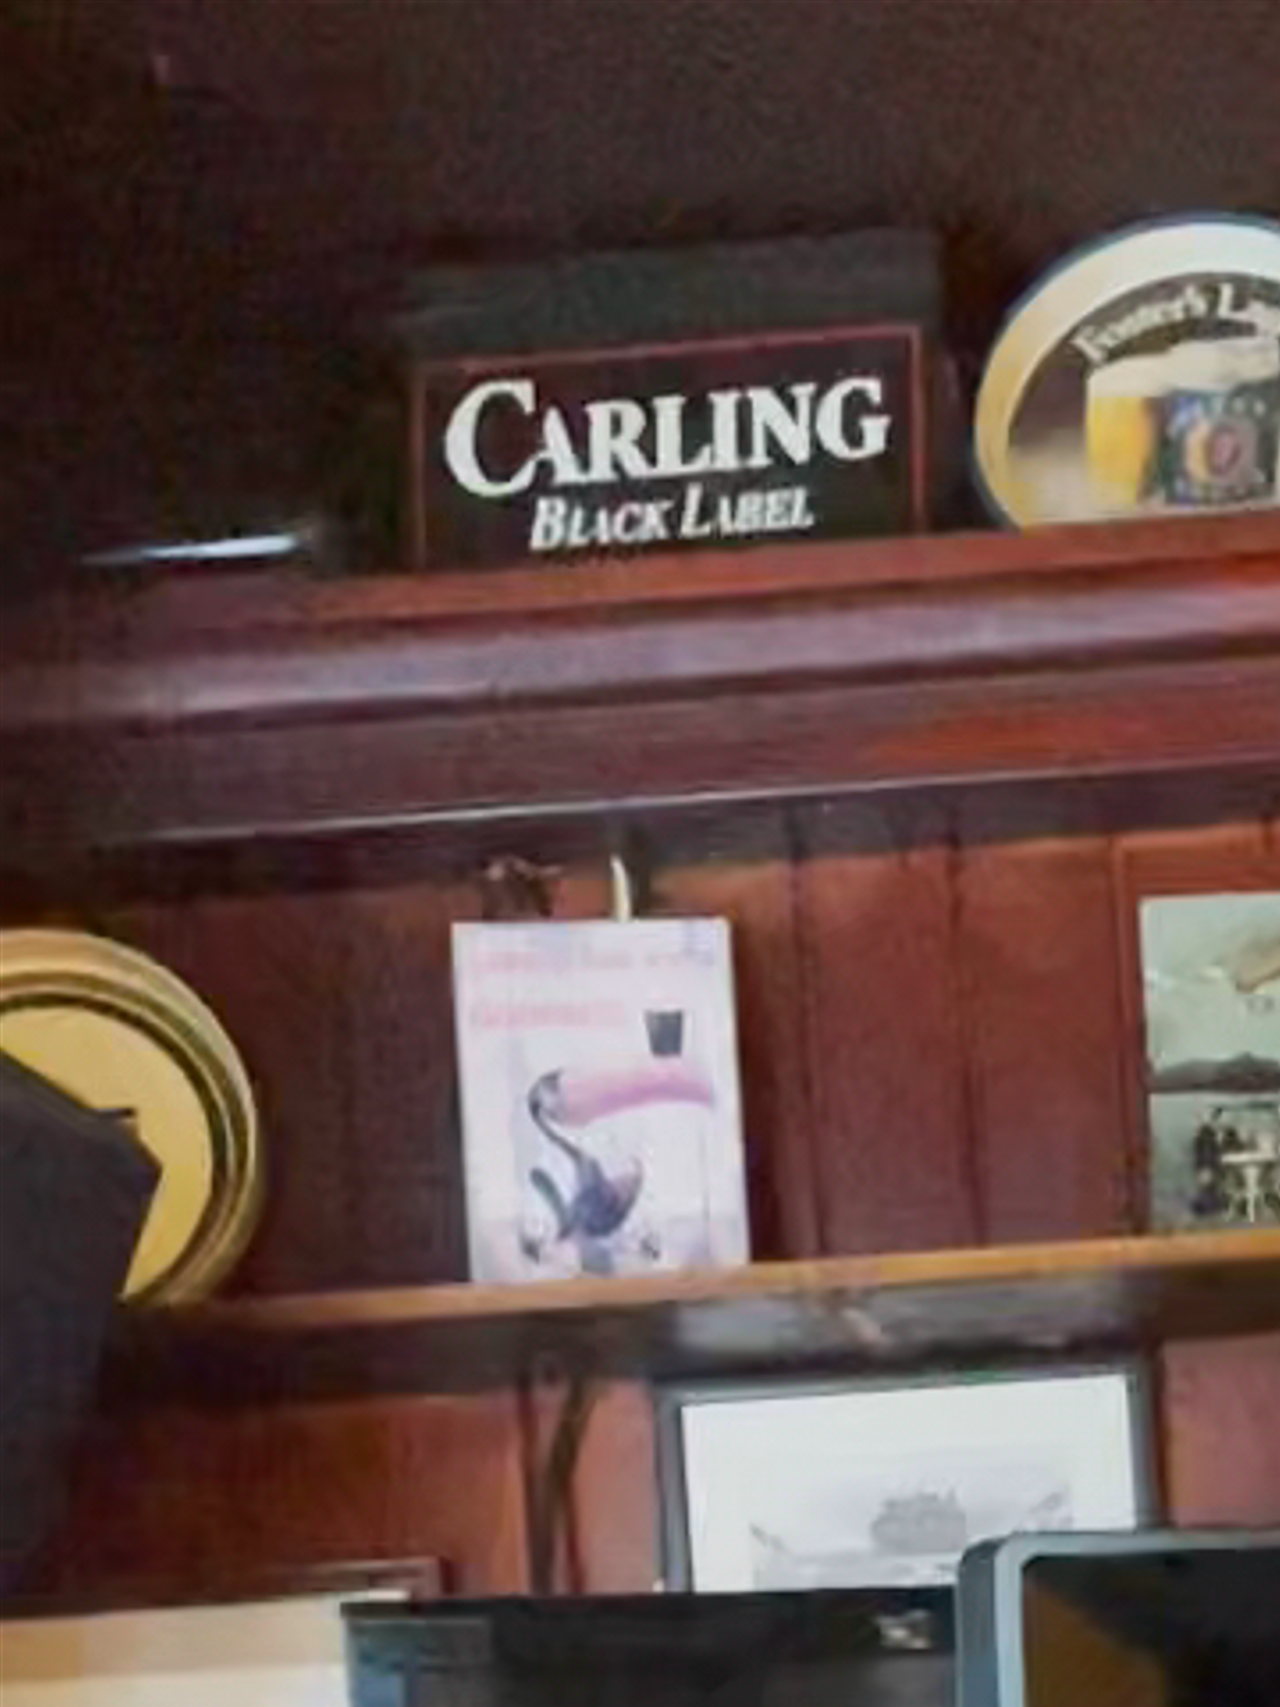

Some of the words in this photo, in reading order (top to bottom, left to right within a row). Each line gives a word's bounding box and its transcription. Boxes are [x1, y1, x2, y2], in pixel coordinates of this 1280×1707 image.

[443, 376, 893, 497] CARLING
[529, 496, 674, 551] BLACK
[679, 482, 815, 539] LABEL
